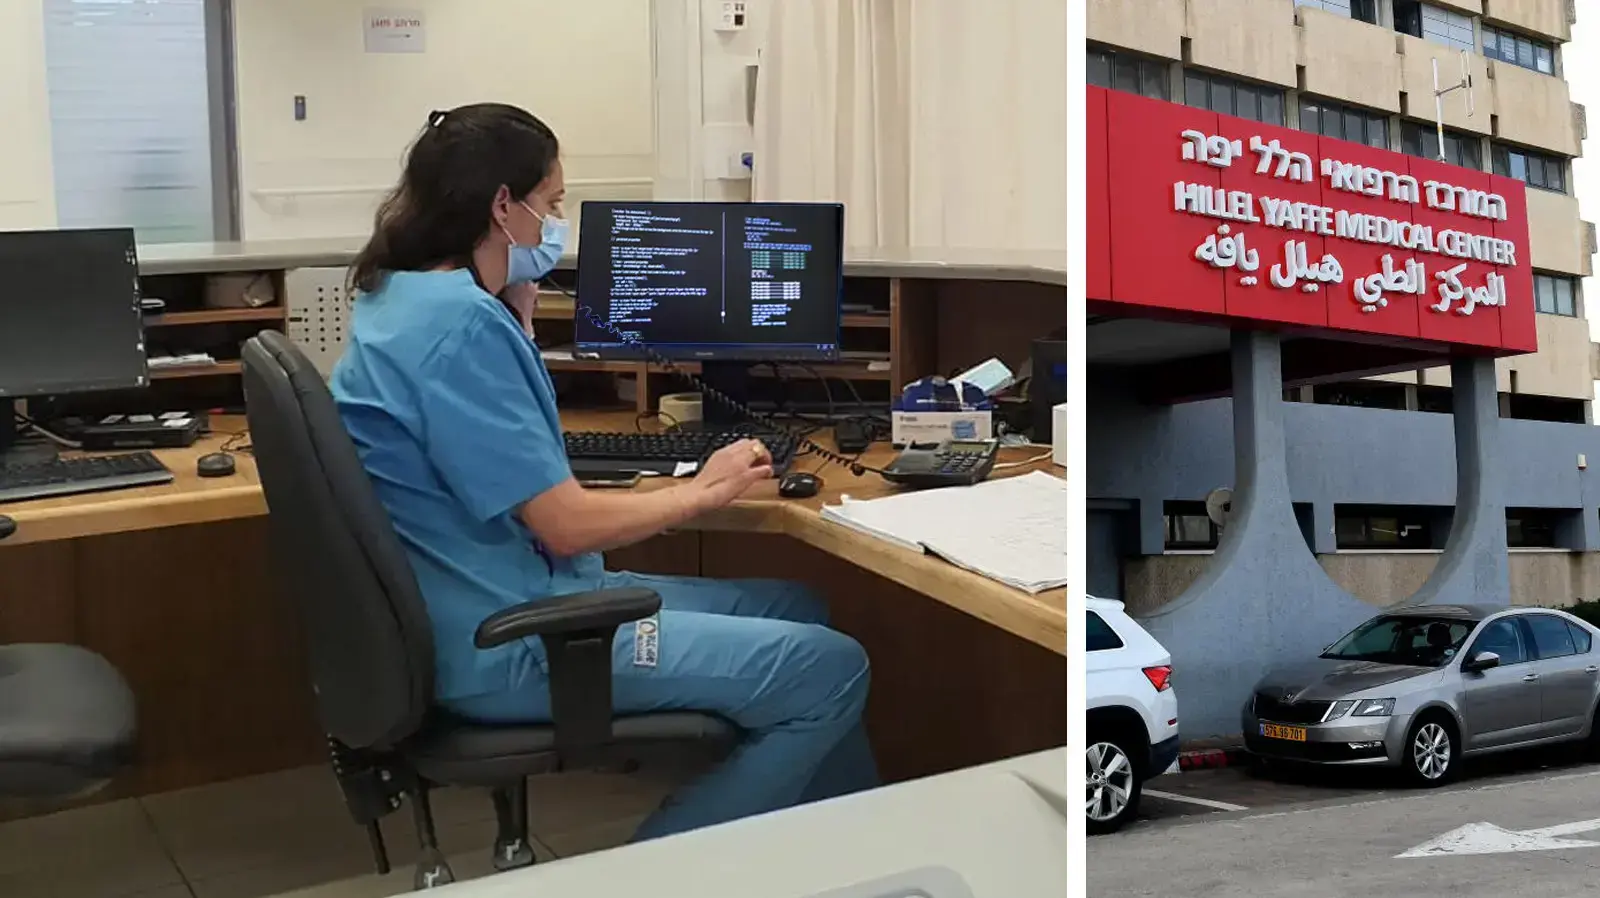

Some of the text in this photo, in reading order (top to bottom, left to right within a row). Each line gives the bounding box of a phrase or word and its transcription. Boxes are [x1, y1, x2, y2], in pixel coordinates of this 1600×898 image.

[1181, 129, 1507, 221] המרכז הרפואי הלל יפה
[1174, 181, 1517, 267] HILLEL YAFFE MEDICAL CENTER
[1269, 239, 1344, 292] هيلل
[1353, 253, 1426, 313] الطبي
[1430, 263, 1506, 316] المركز
